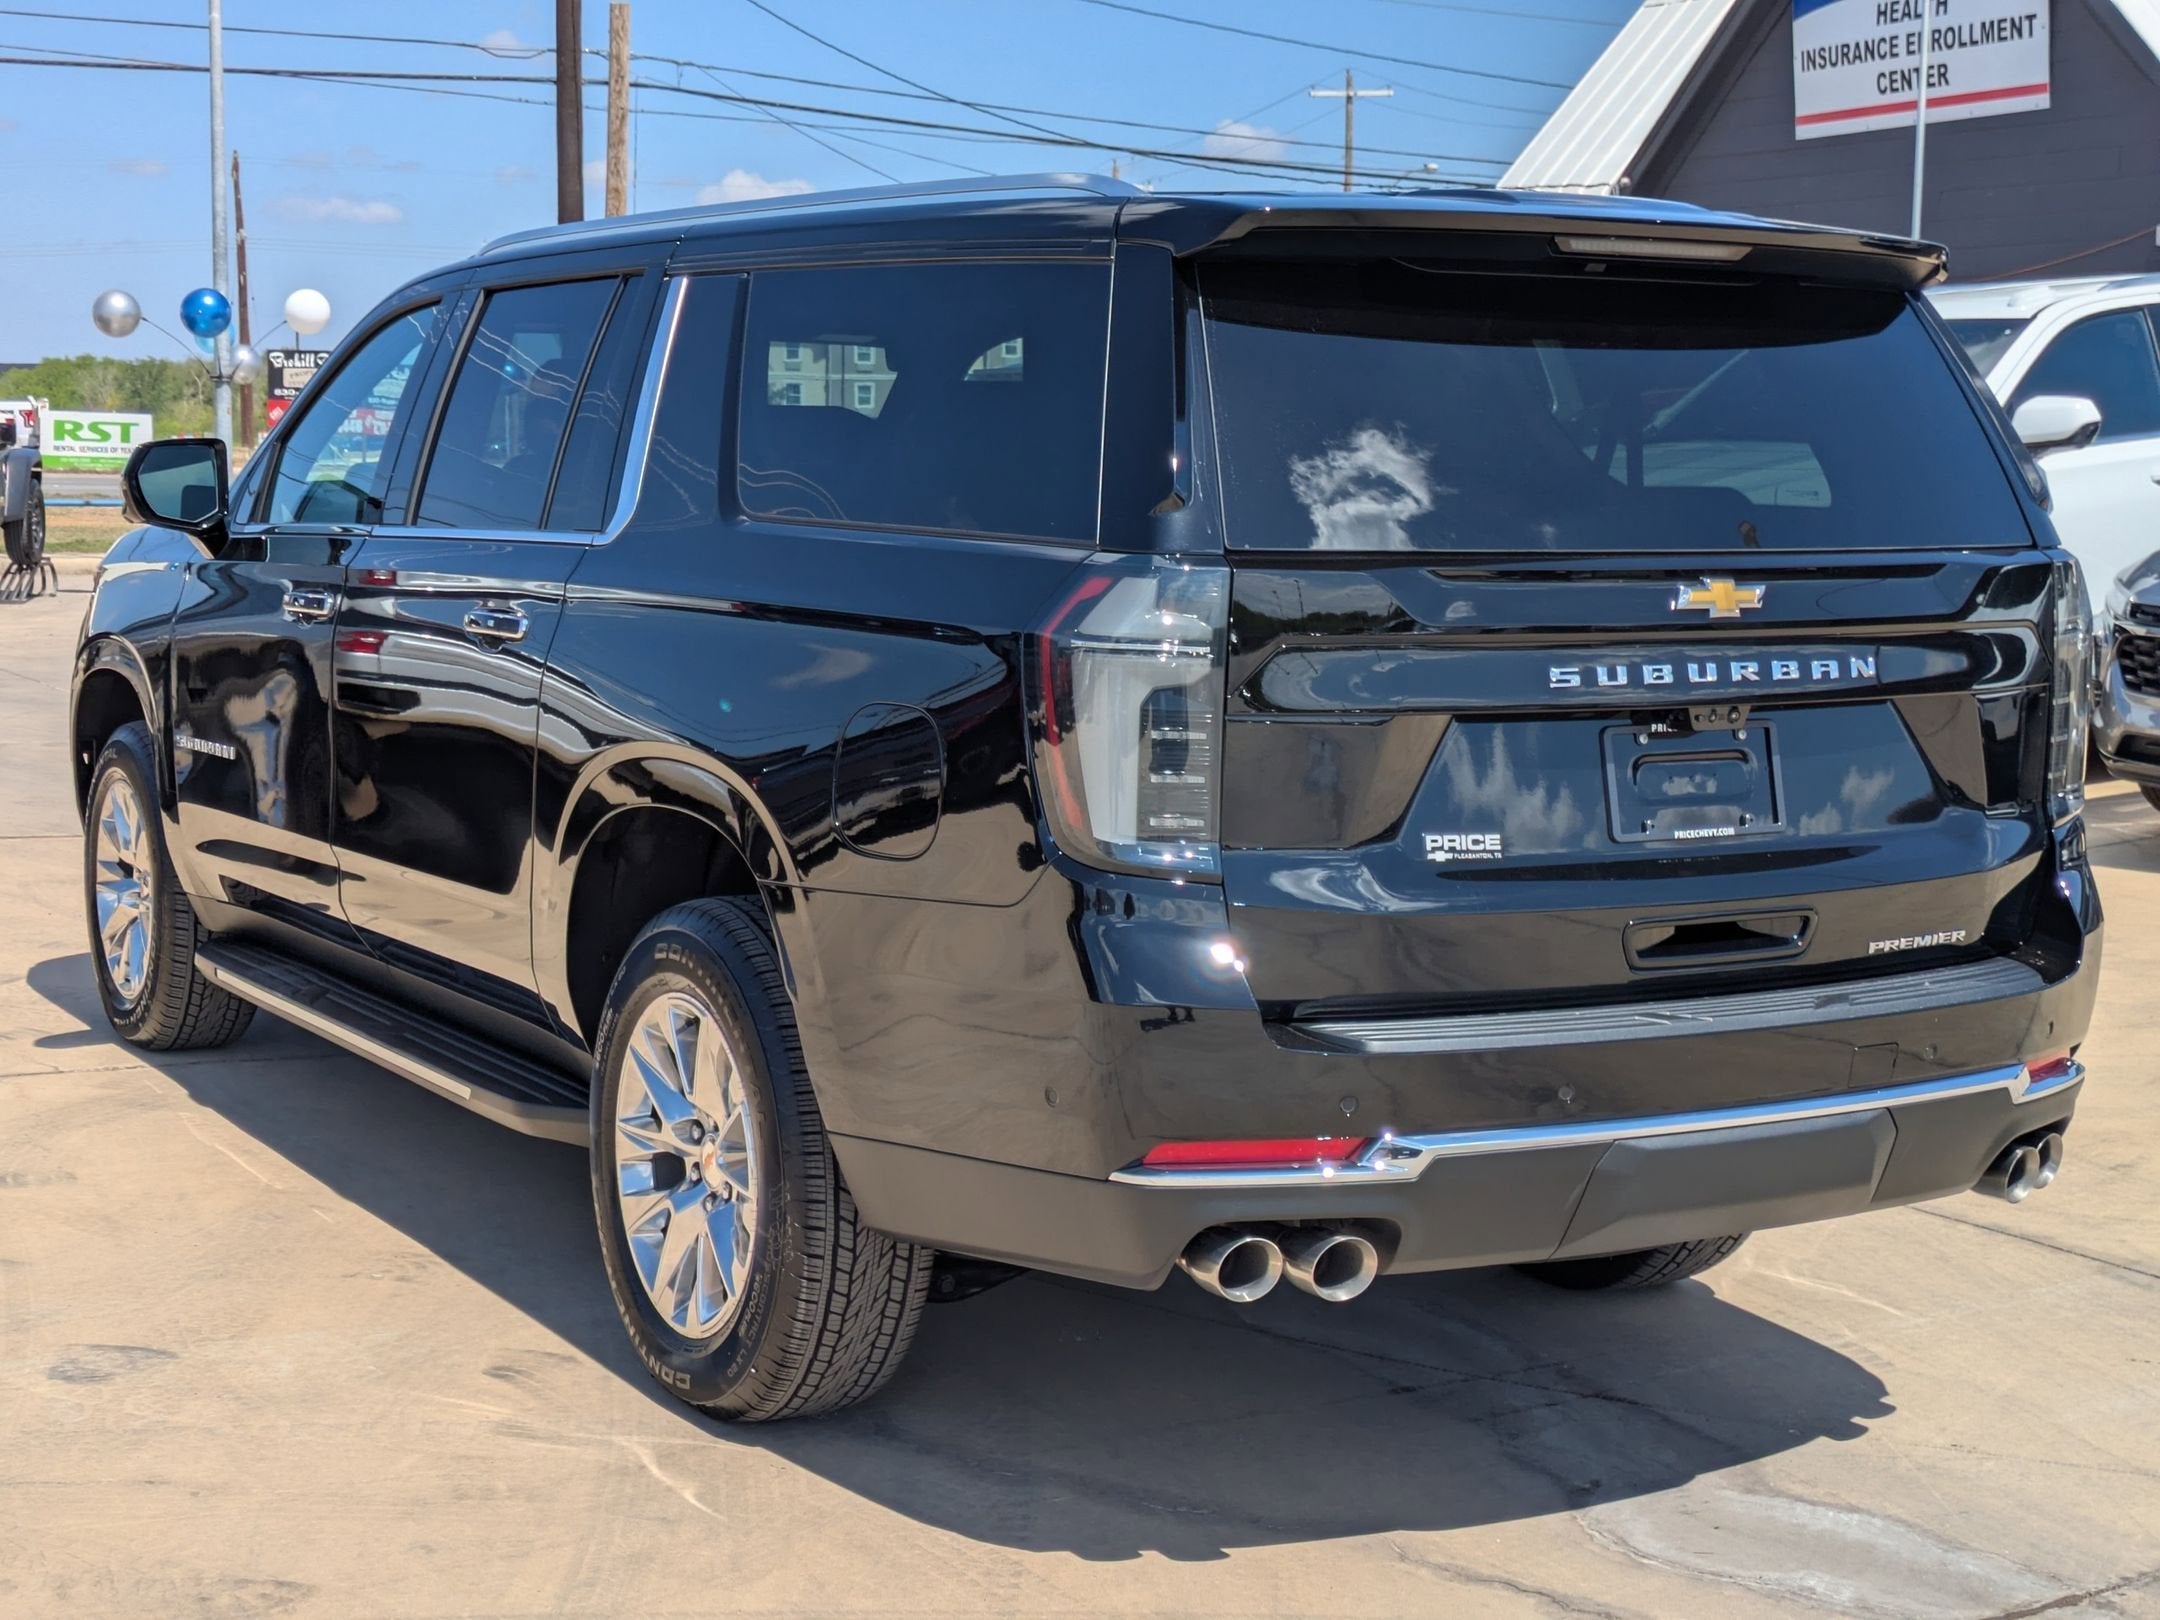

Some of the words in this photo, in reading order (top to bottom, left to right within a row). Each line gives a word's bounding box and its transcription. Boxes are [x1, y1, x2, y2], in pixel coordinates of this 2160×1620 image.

[1876, 0, 1948, 26] HEALH
[1801, 35, 1900, 72] INSURANCE
[1906, 14, 2037, 56] EROLLMENT
[1876, 63, 1950, 95] CENTER
[53, 419, 139, 443] RST
[1549, 656, 1875, 689] SUBURBAN
[1425, 833, 1502, 851] PRICE
[1674, 827, 1735, 839] PRICECHEVY.COM
[1868, 930, 1966, 954] PREMIER
